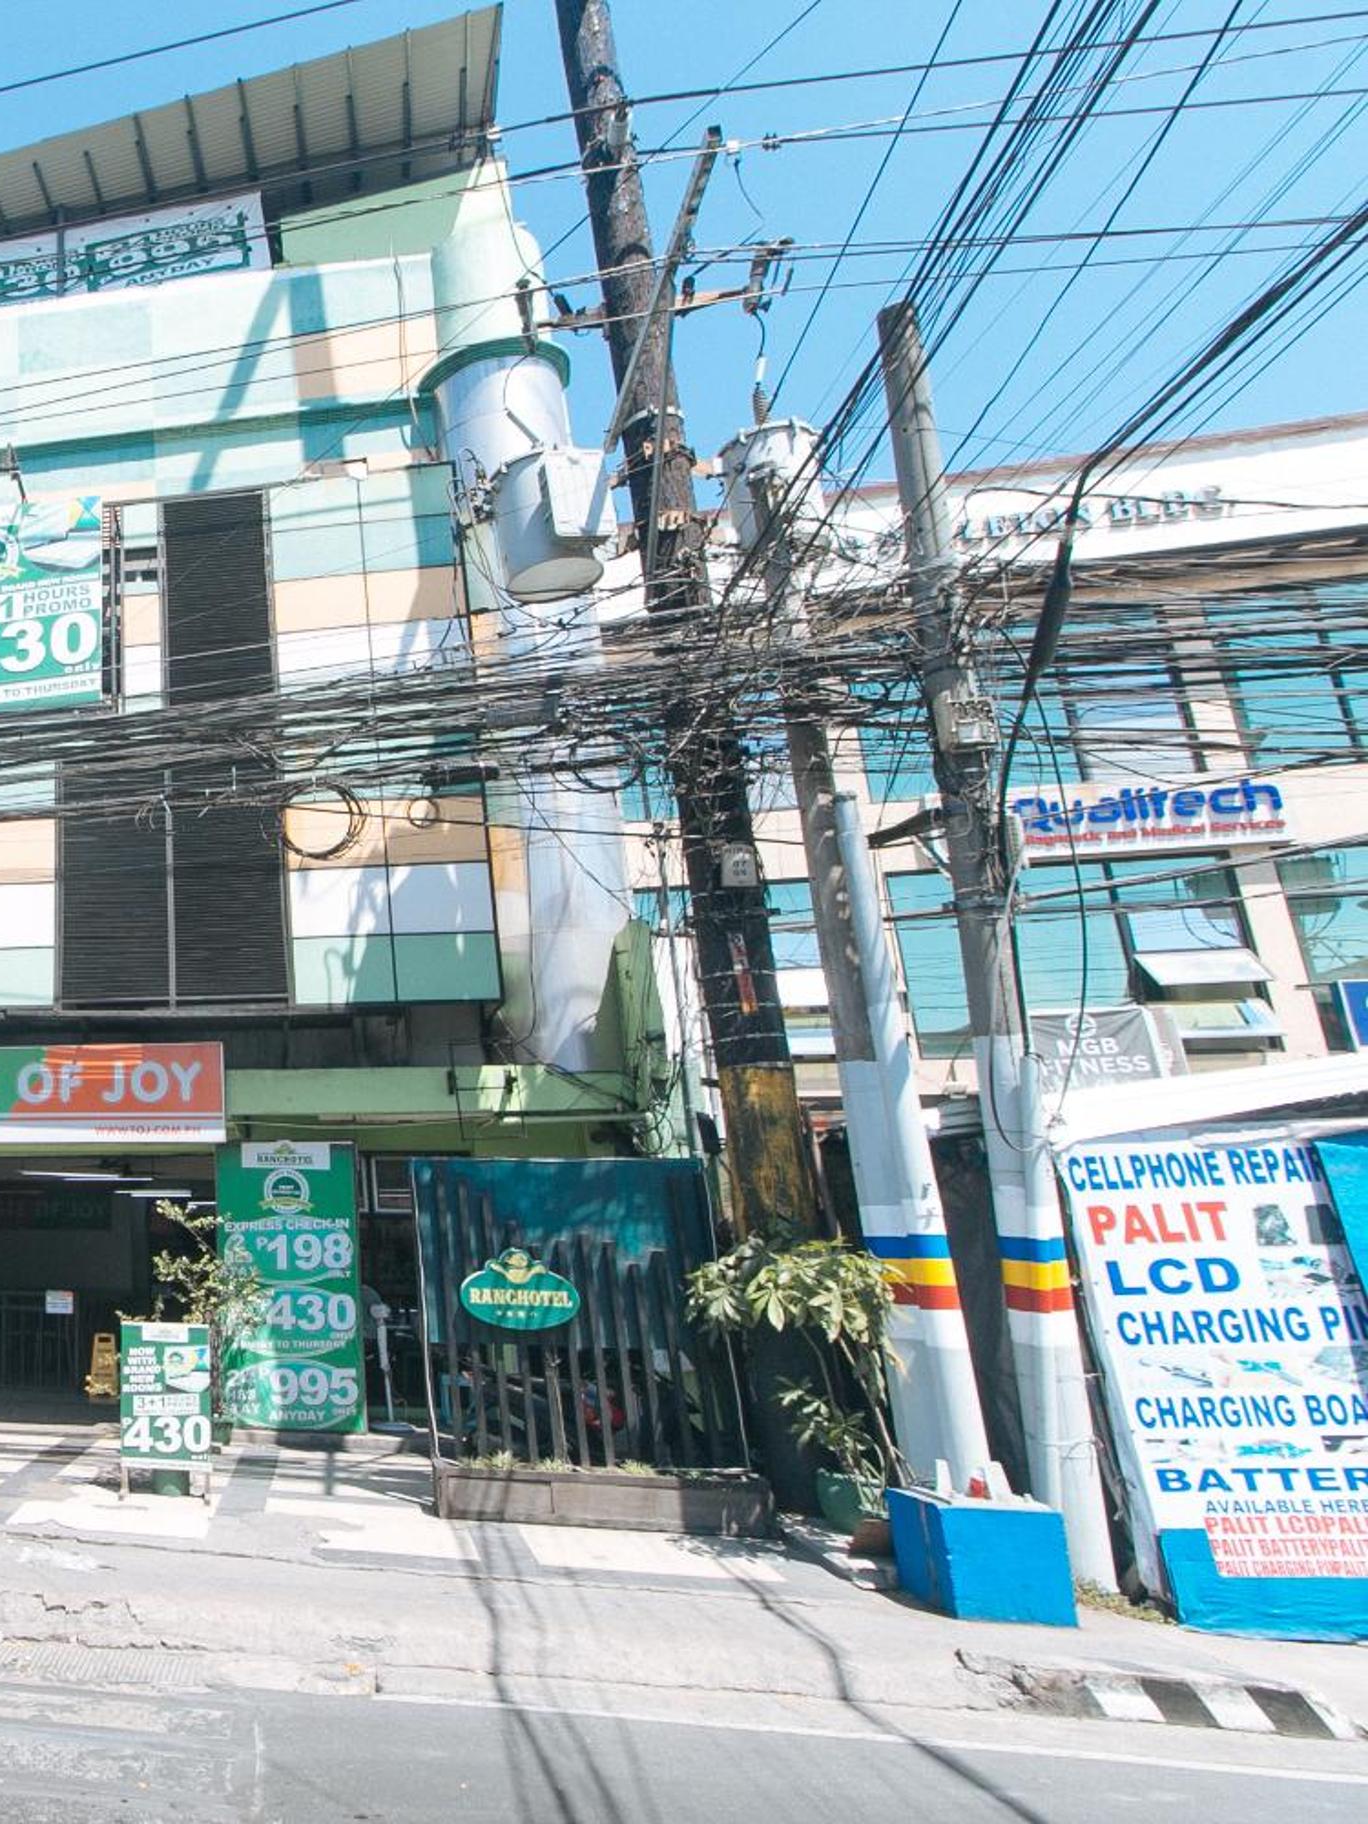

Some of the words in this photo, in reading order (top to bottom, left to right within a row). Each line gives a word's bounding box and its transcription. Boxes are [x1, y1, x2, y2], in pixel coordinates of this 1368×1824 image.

[125, 256, 217, 288] ANYDAY
[24, 584, 91, 604] HOURS
[23, 597, 93, 617] PROMO
[5, 688, 22, 698] TO
[27, 678, 97, 696] THURSDAY
[1014, 778, 1283, 832] Qualitech
[1141, 823, 1205, 838] Medical
[1210, 819, 1286, 833] Services
[1056, 1036, 1120, 1057] MGB
[17, 1060, 84, 1105] OF
[100, 1060, 203, 1104] JOY
[1067, 1151, 1225, 1192] CELLPHONE
[224, 1220, 283, 1232] EXPRESS
[286, 1217, 350, 1230] CHECK-IN
[1087, 1201, 1228, 1246] PALIT
[1105, 1257, 1242, 1296] LCD
[469, 1286, 573, 1308] RANCHOTEL
[1117, 1306, 1312, 1346] CHARGING
[127, 1356, 158, 1365] WITH
[128, 1346, 157, 1356] NOW
[122, 1365, 161, 1375] BRAND
[128, 1374, 156, 1383] NEW
[121, 1383, 163, 1393] ROOMS
[269, 1409, 326, 1421] ANYDAY
[1135, 1394, 1297, 1429] CHARGING
[1206, 1499, 1315, 1514] AVAILABLE
[1204, 1515, 1269, 1535] PALIT
[1209, 1539, 1255, 1557] PALIT
[1216, 1560, 1250, 1577] PALIT
[1253, 1560, 1316, 1577] CHARGING
